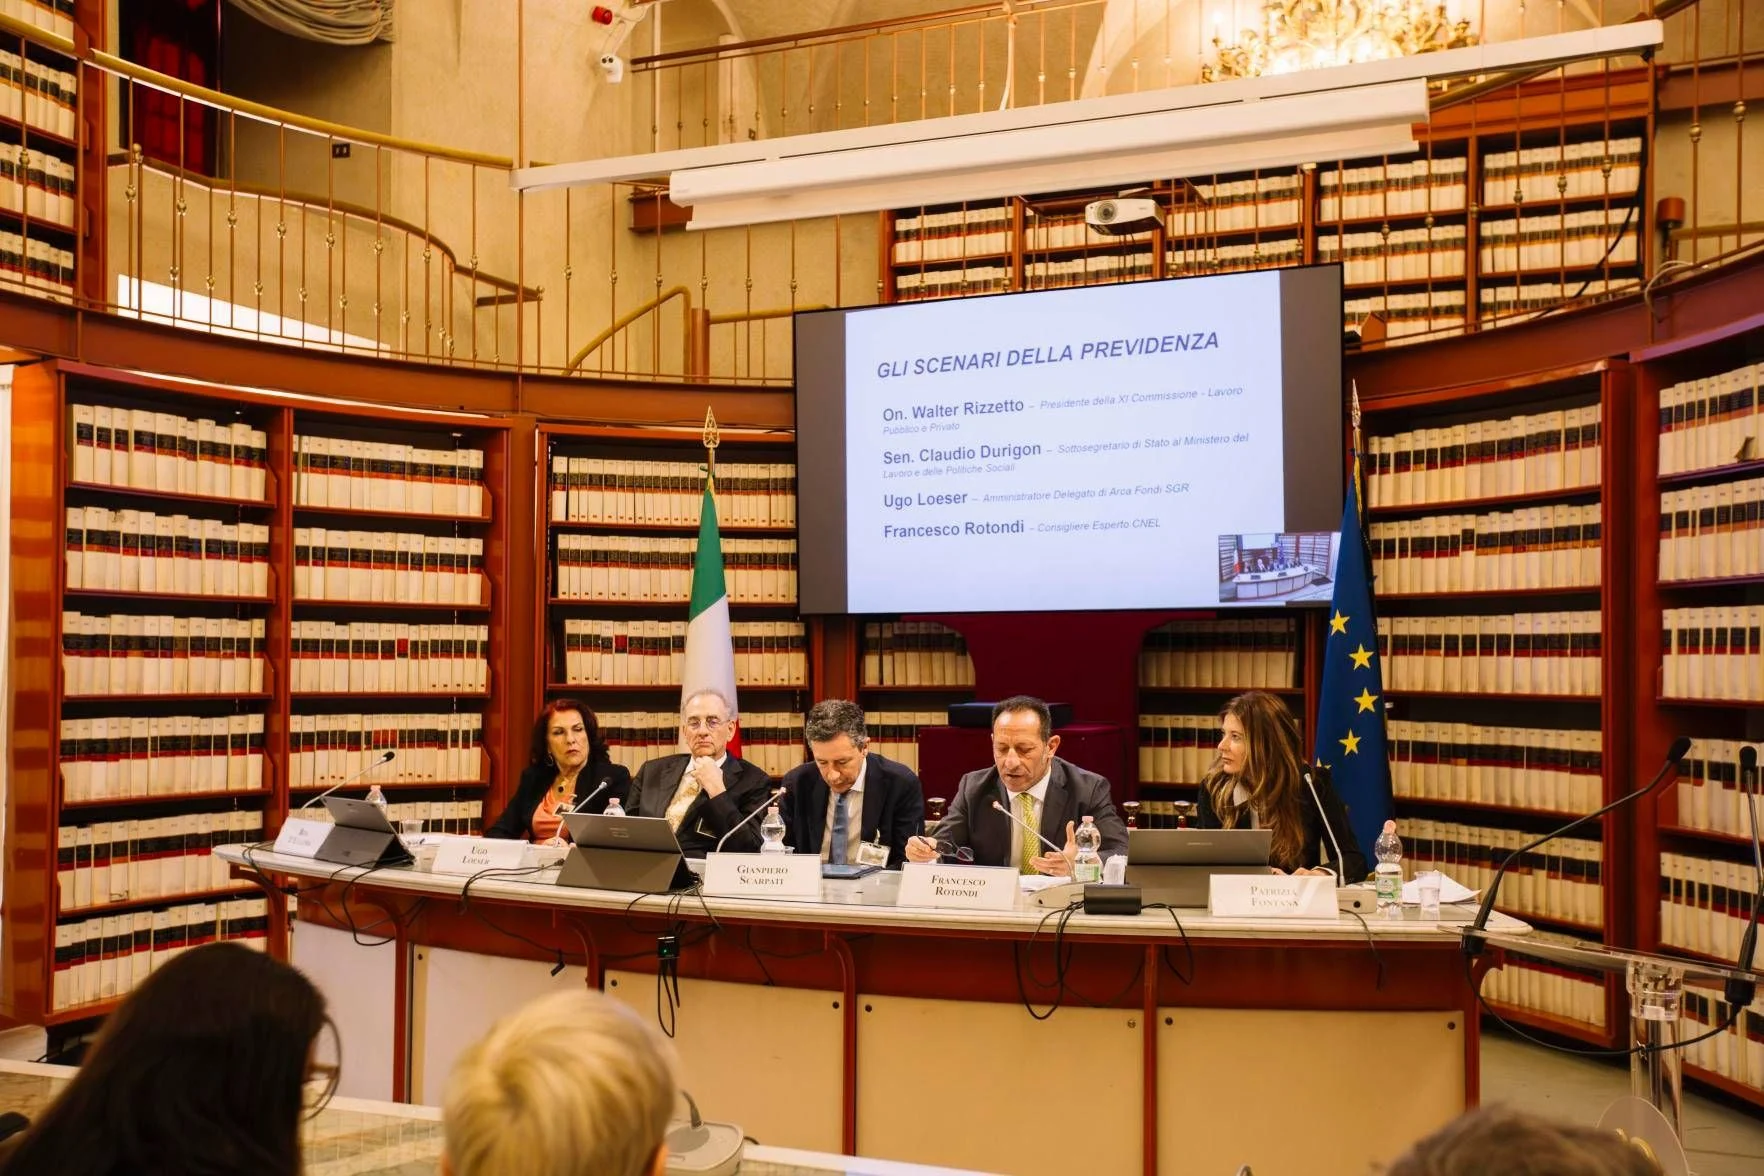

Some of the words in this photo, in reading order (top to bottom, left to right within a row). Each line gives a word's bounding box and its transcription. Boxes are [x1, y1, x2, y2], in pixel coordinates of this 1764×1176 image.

[877, 360, 908, 378] GLI
[913, 351, 1001, 375] SCENARI
[1006, 344, 1073, 366] DELLA
[1080, 331, 1219, 360] PREVIDENZA
[883, 408, 908, 422] On.
[912, 404, 959, 419] Walter
[963, 399, 1024, 416] Rizzetto
[1040, 397, 1090, 410] Presidente
[1092, 396, 1115, 406] della
[1118, 394, 1129, 403] XI
[1131, 390, 1198, 403] Commissione
[1208, 387, 1243, 397] Lavoro
[883, 424, 919, 435] Pubblico
[929, 422, 960, 433] Privato
[883, 451, 914, 465] Sen.
[919, 446, 976, 463] Claudio
[980, 444, 1041, 460] Durigon
[1059, 440, 1130, 454] Sottosegretario
[1132, 439, 1141, 449] di
[1144, 438, 1169, 449] Stato
[1172, 436, 1181, 446] al
[1184, 434, 1230, 446] Ministero
[1233, 432, 1249, 443] del
[883, 469, 913, 479] Lavoro
[922, 467, 943, 477] delle
[946, 464, 983, 475] Politiche
[985, 462, 1015, 472] Sociali
[883, 494, 913, 510] Ugo
[917, 492, 968, 506] Loeser
[983, 490, 1051, 503] Amministratore
[1053, 488, 1096, 501] Delegato
[1099, 487, 1106, 497] di
[1109, 486, 1132, 497] Arca
[1134, 484, 1162, 496] Fondi
[1165, 482, 1189, 494] SGR
[884, 523, 960, 538] Francesco
[965, 519, 1024, 535] Rotondi
[1037, 520, 1089, 534] Consigliere
[1092, 518, 1130, 531] Esperto
[1133, 517, 1161, 529] CNEL
